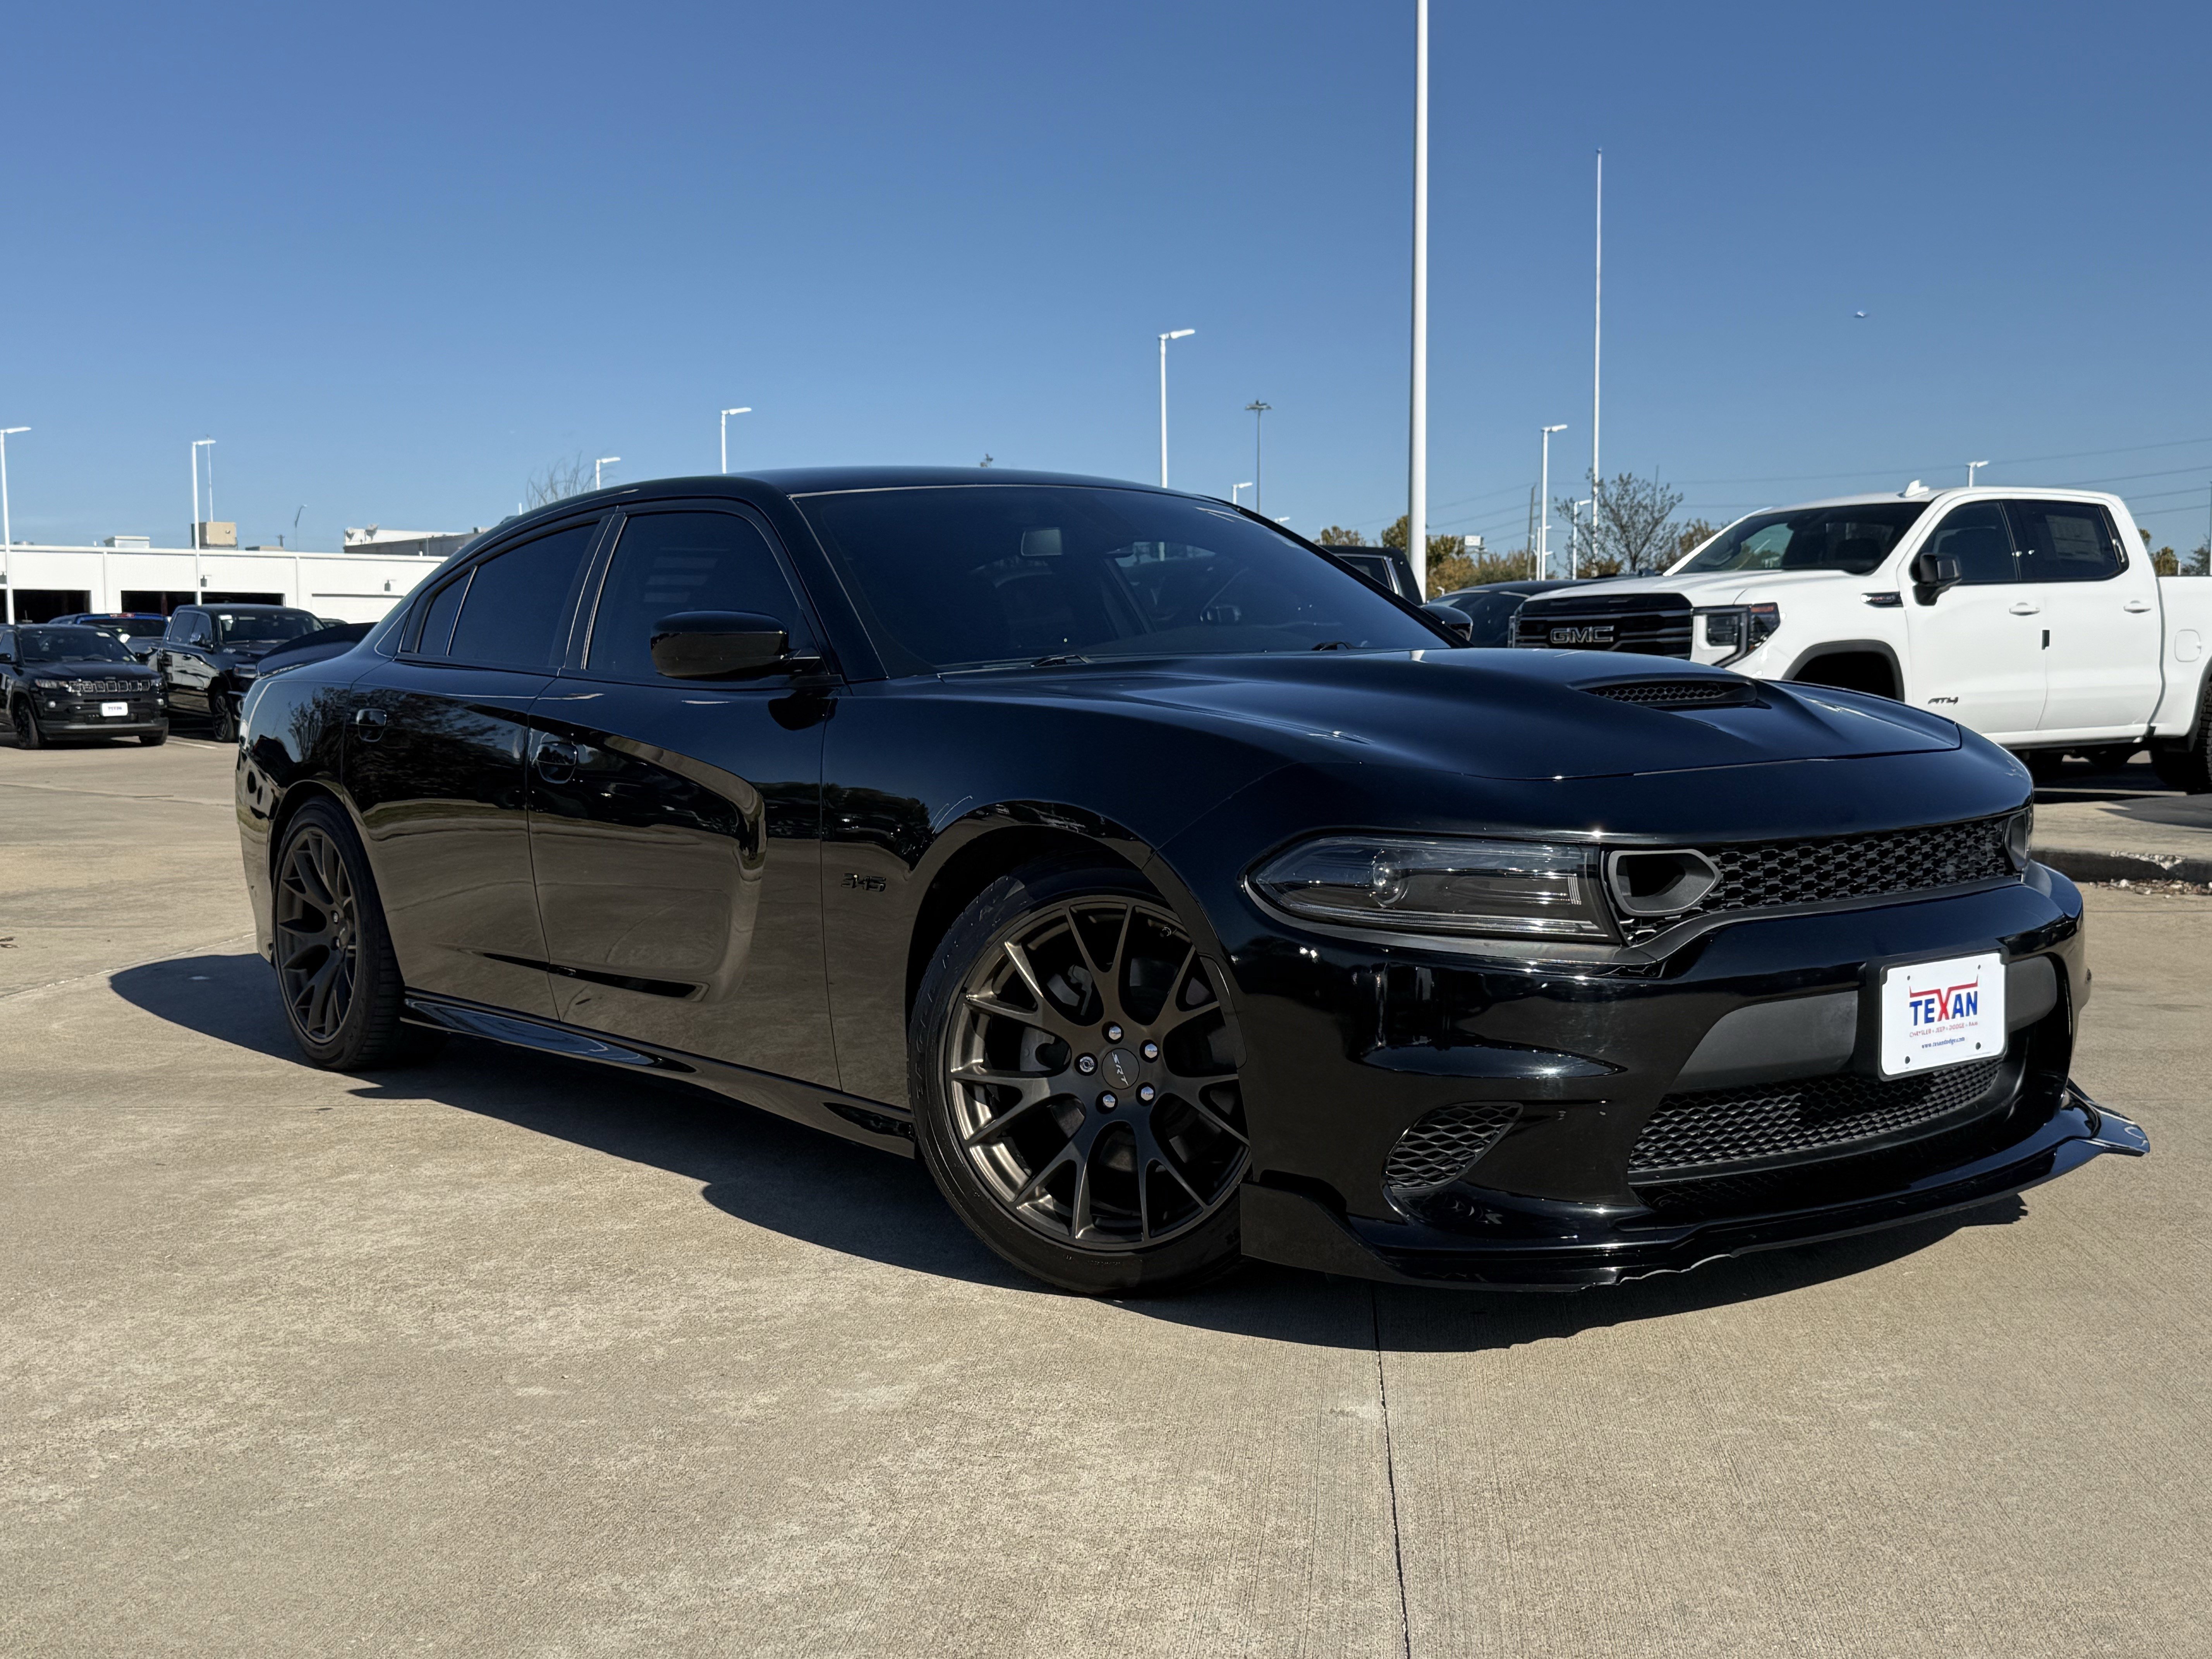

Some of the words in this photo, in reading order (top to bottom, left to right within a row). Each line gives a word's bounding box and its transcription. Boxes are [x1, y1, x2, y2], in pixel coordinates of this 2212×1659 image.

[1550, 625, 1614, 644] GMC
[1928, 697, 1958, 706] AT4
[841, 873, 886, 892] 345
[1909, 988, 1977, 1026] TEXAN
[1112, 1052, 1128, 1085] SRT
